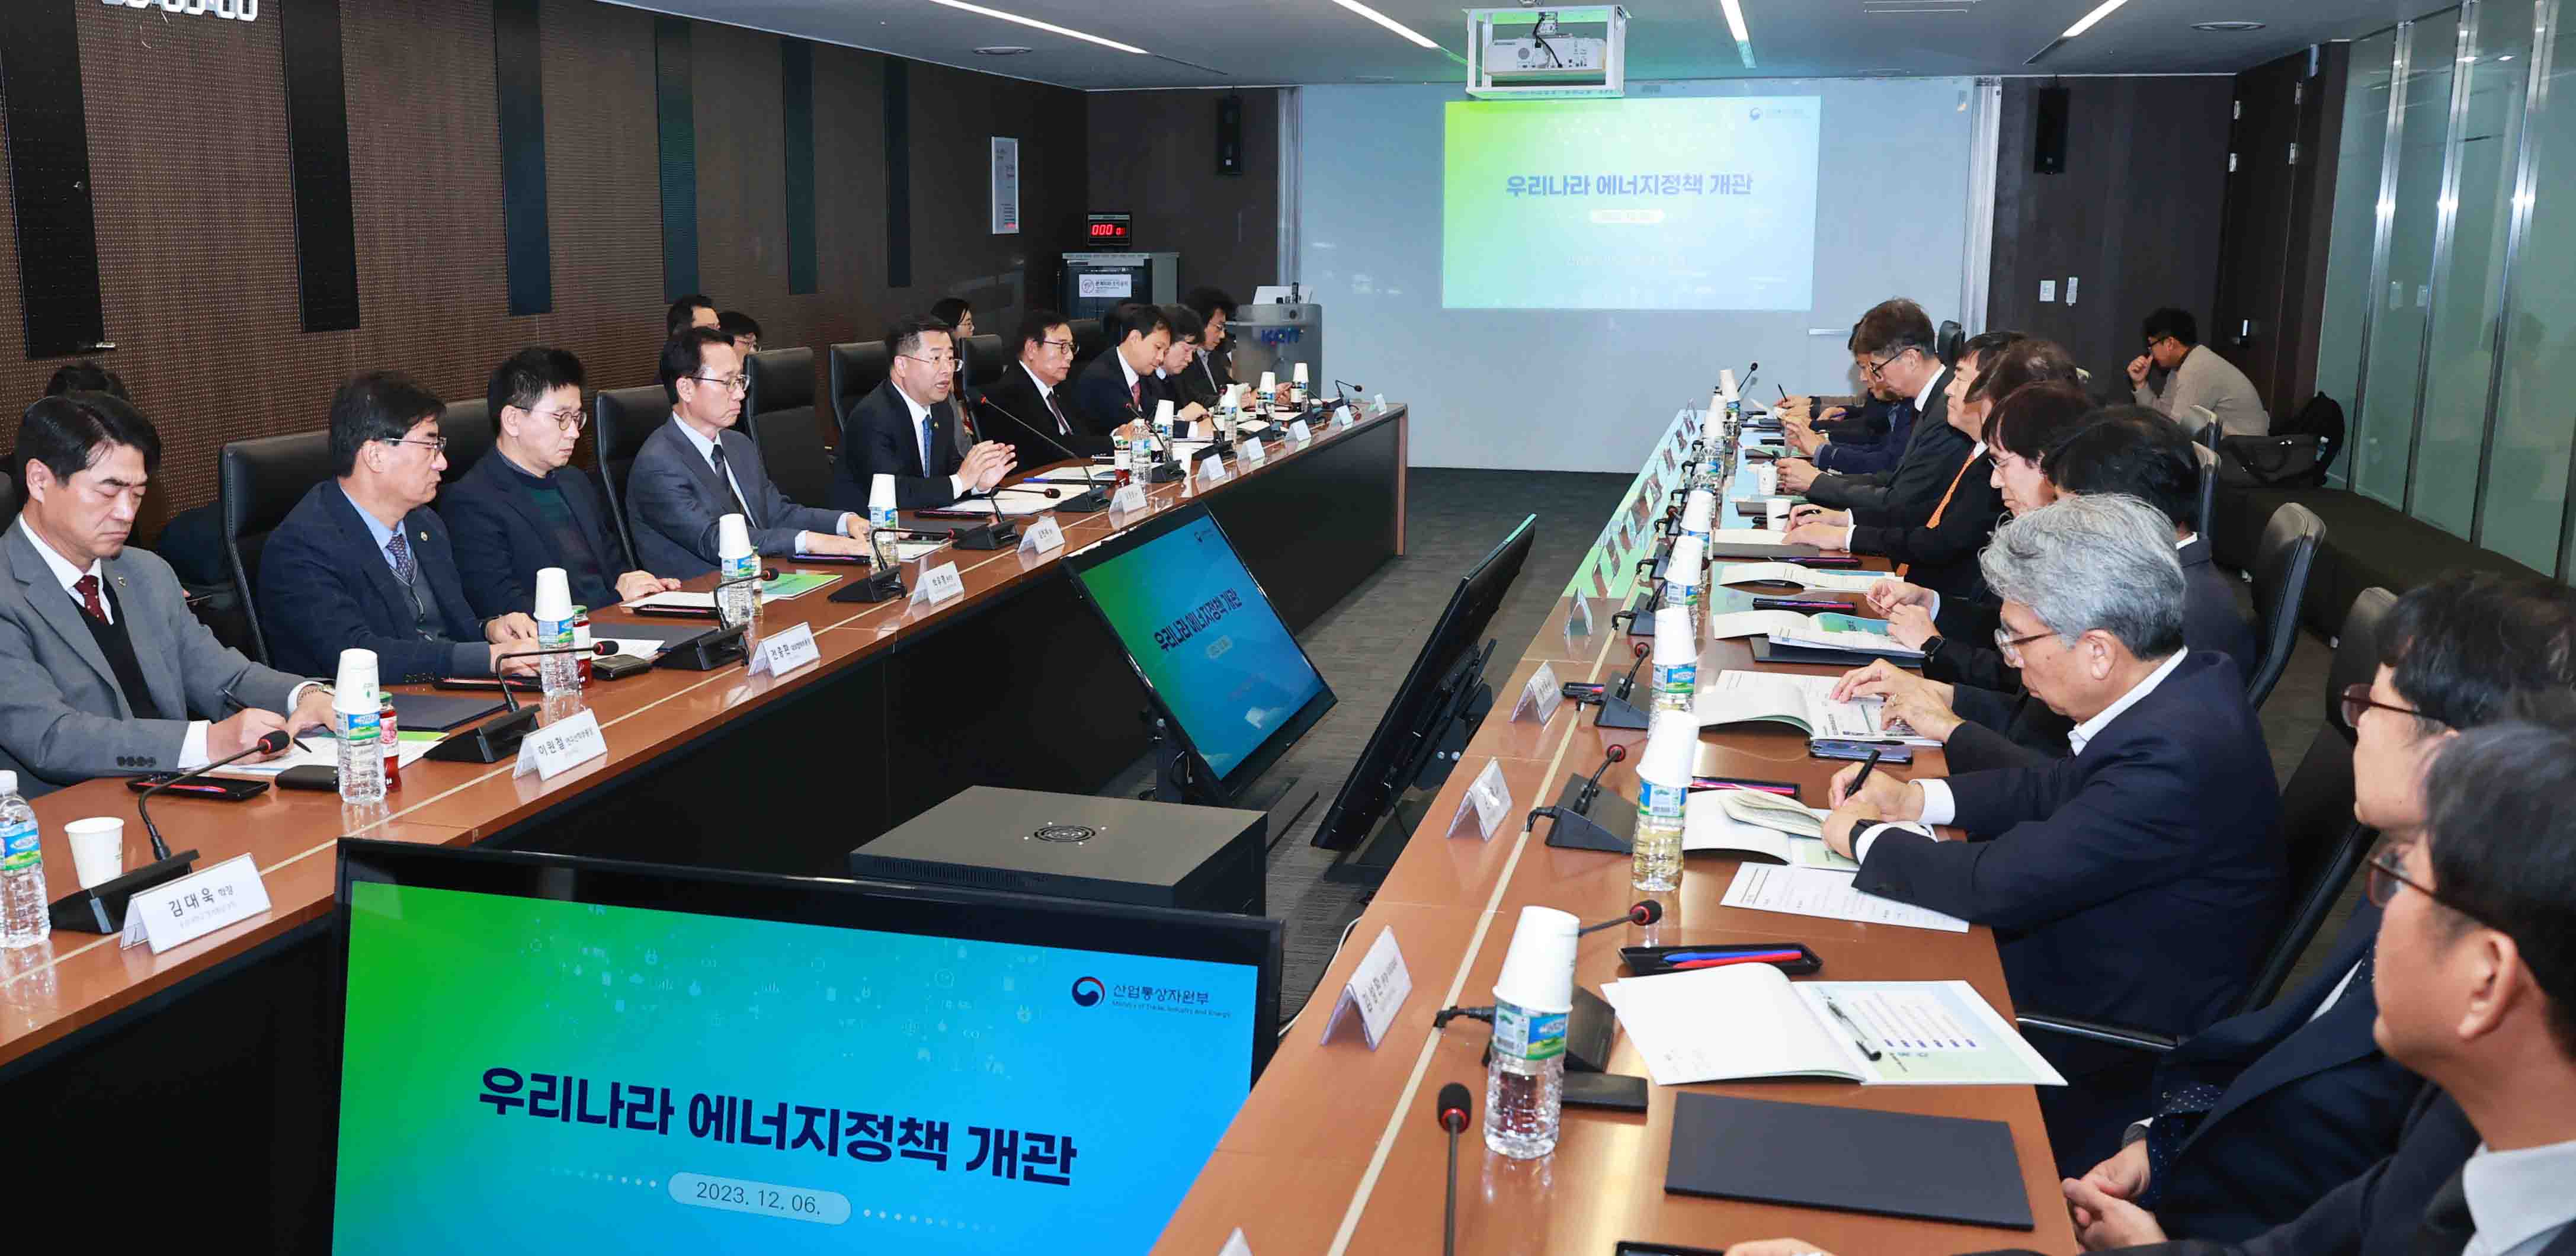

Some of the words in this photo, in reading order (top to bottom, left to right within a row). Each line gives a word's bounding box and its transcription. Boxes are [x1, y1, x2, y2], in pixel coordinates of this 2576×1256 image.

[1507, 174, 1590, 197] 우리나라
[1595, 174, 1703, 196] 에너지정책
[1710, 174, 1753, 196] 개관
[1154, 617, 1194, 652] 우리나라
[1184, 596, 1229, 632] 에너지정책
[1218, 587, 1242, 611] 개관
[1113, 983, 1209, 1005] 산업통상자원부
[478, 1067, 675, 1136] 우리나라
[688, 1093, 950, 1172] 에너지정책
[966, 1126, 1078, 1185] 개관
[696, 1181, 750, 1206] 2023.
[757, 1189, 786, 1210] 12.
[792, 1194, 822, 1216] 06.
